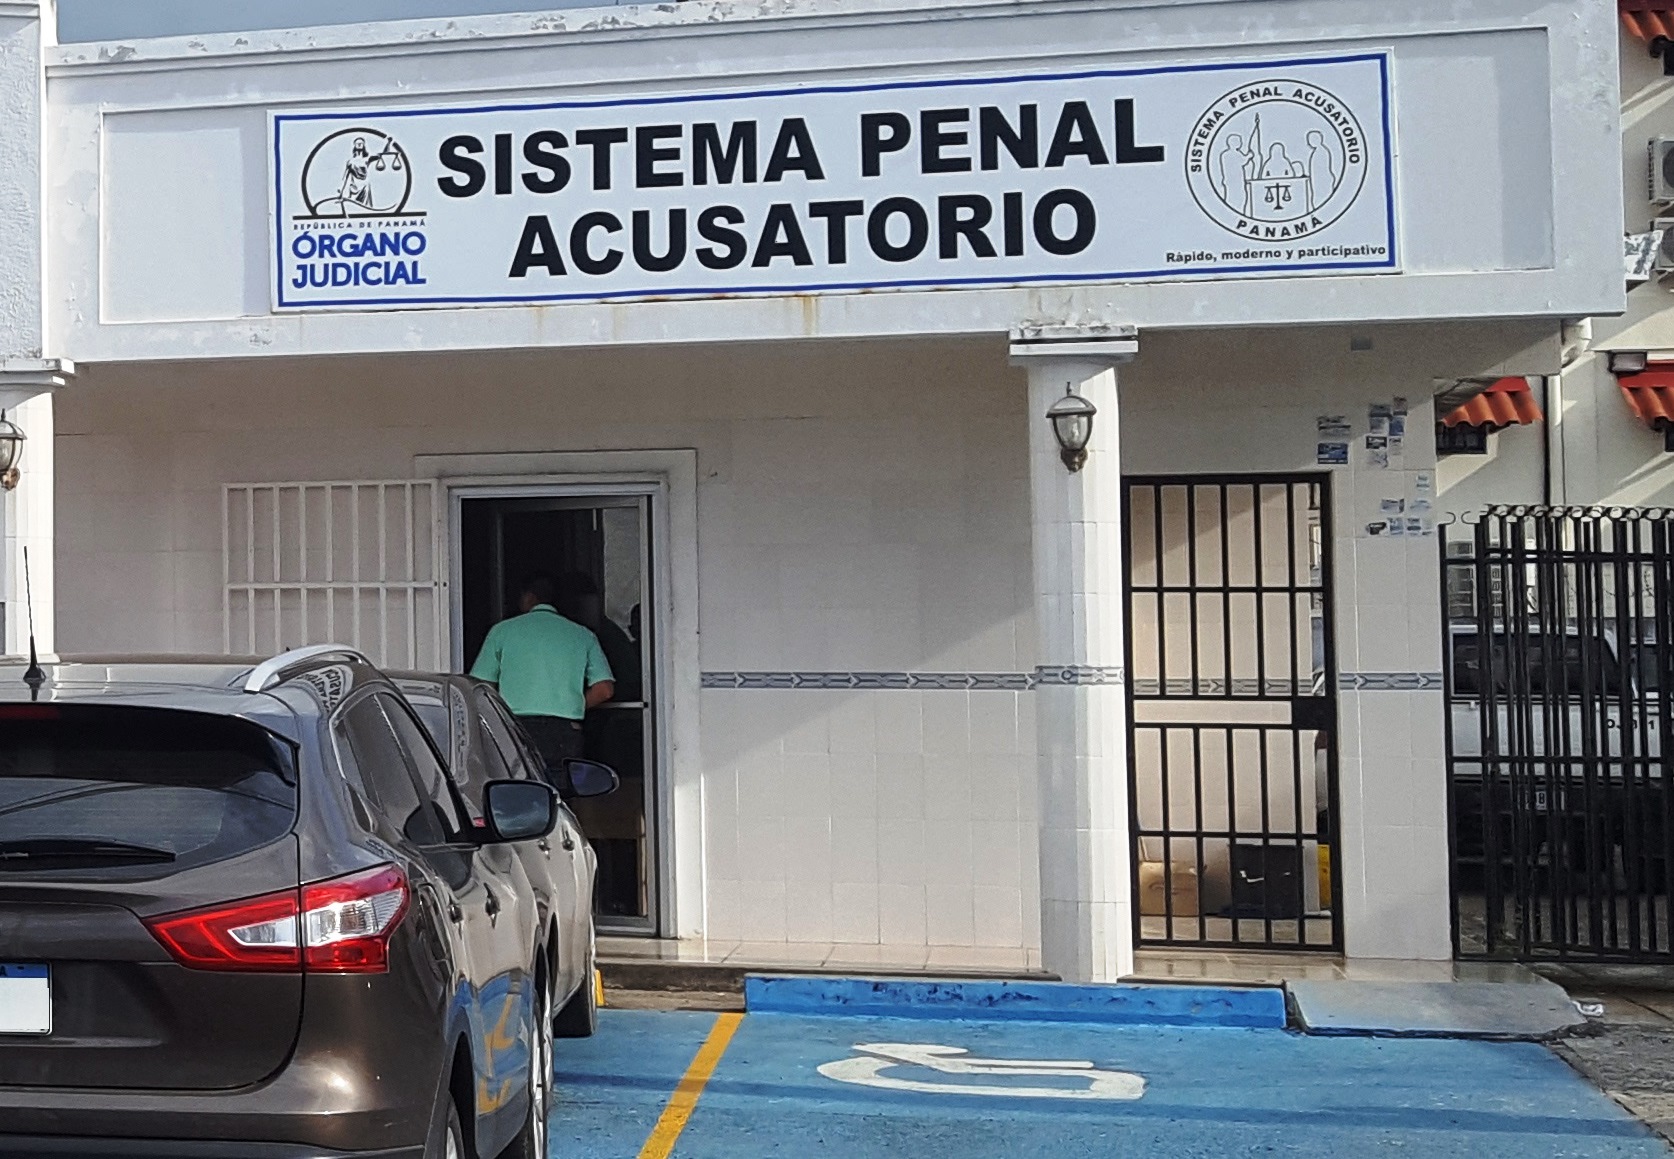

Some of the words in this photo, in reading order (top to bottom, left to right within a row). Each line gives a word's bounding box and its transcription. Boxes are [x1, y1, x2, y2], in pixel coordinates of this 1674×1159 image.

[1191, 110, 1225, 173] SISTEMA
[1229, 86, 1283, 109] PENAL
[1292, 88, 1360, 164] ACUSATORIO
[438, 121, 824, 198] SISTEMA
[861, 98, 1164, 177] PENAL
[294, 222, 353, 231] REPÚBLICA
[359, 221, 371, 229] DE
[378, 219, 426, 228] PANAMÁ
[508, 188, 1096, 278] ACUSATORIO
[1236, 215, 1323, 238] PANAMÁ
[292, 231, 426, 259] ÓRGANO
[1166, 251, 1218, 264] Rápido,
[1221, 249, 1282, 261] moderno
[1285, 249, 1294, 260] y
[1298, 245, 1386, 259] participativo
[292, 261, 426, 289] JUDICIAL
